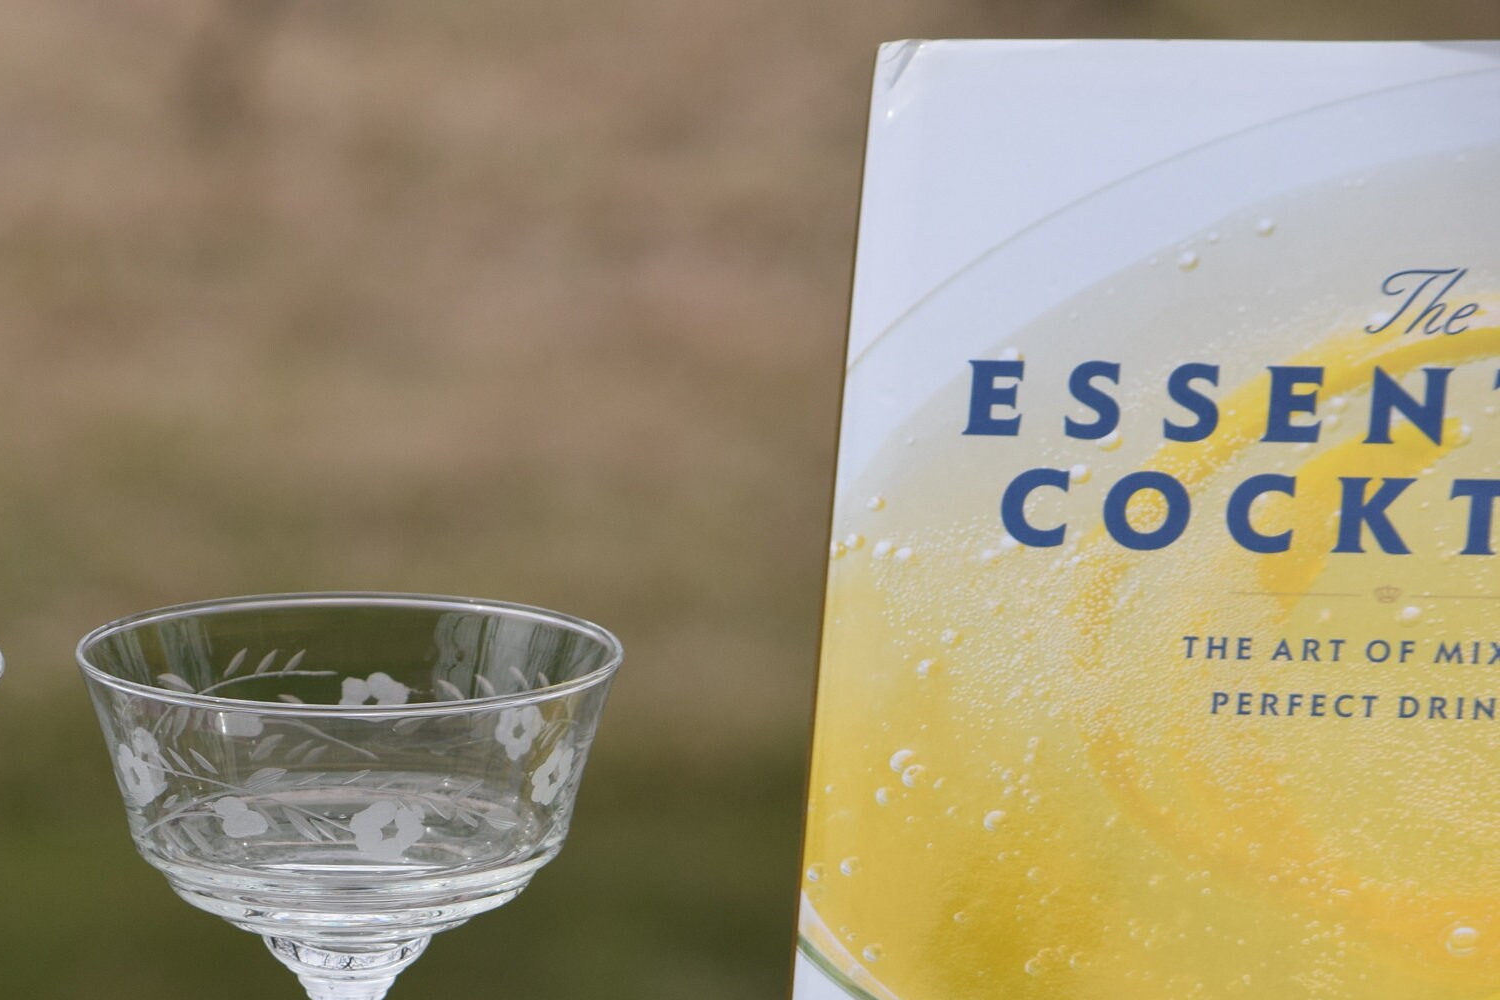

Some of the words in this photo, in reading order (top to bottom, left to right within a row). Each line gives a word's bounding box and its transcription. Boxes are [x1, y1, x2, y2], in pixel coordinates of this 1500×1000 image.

[1365, 267, 1480, 335] The
[961, 359, 1500, 447] ESSEN
[1000, 467, 1500, 556] COCKT
[1182, 635, 1253, 660] THE
[1271, 638, 1346, 662] ART
[1365, 639, 1416, 663] OF
[1433, 640, 1500, 665] MIX
[1210, 691, 1379, 718] PERFECT
[1397, 695, 1498, 720] DRIN
